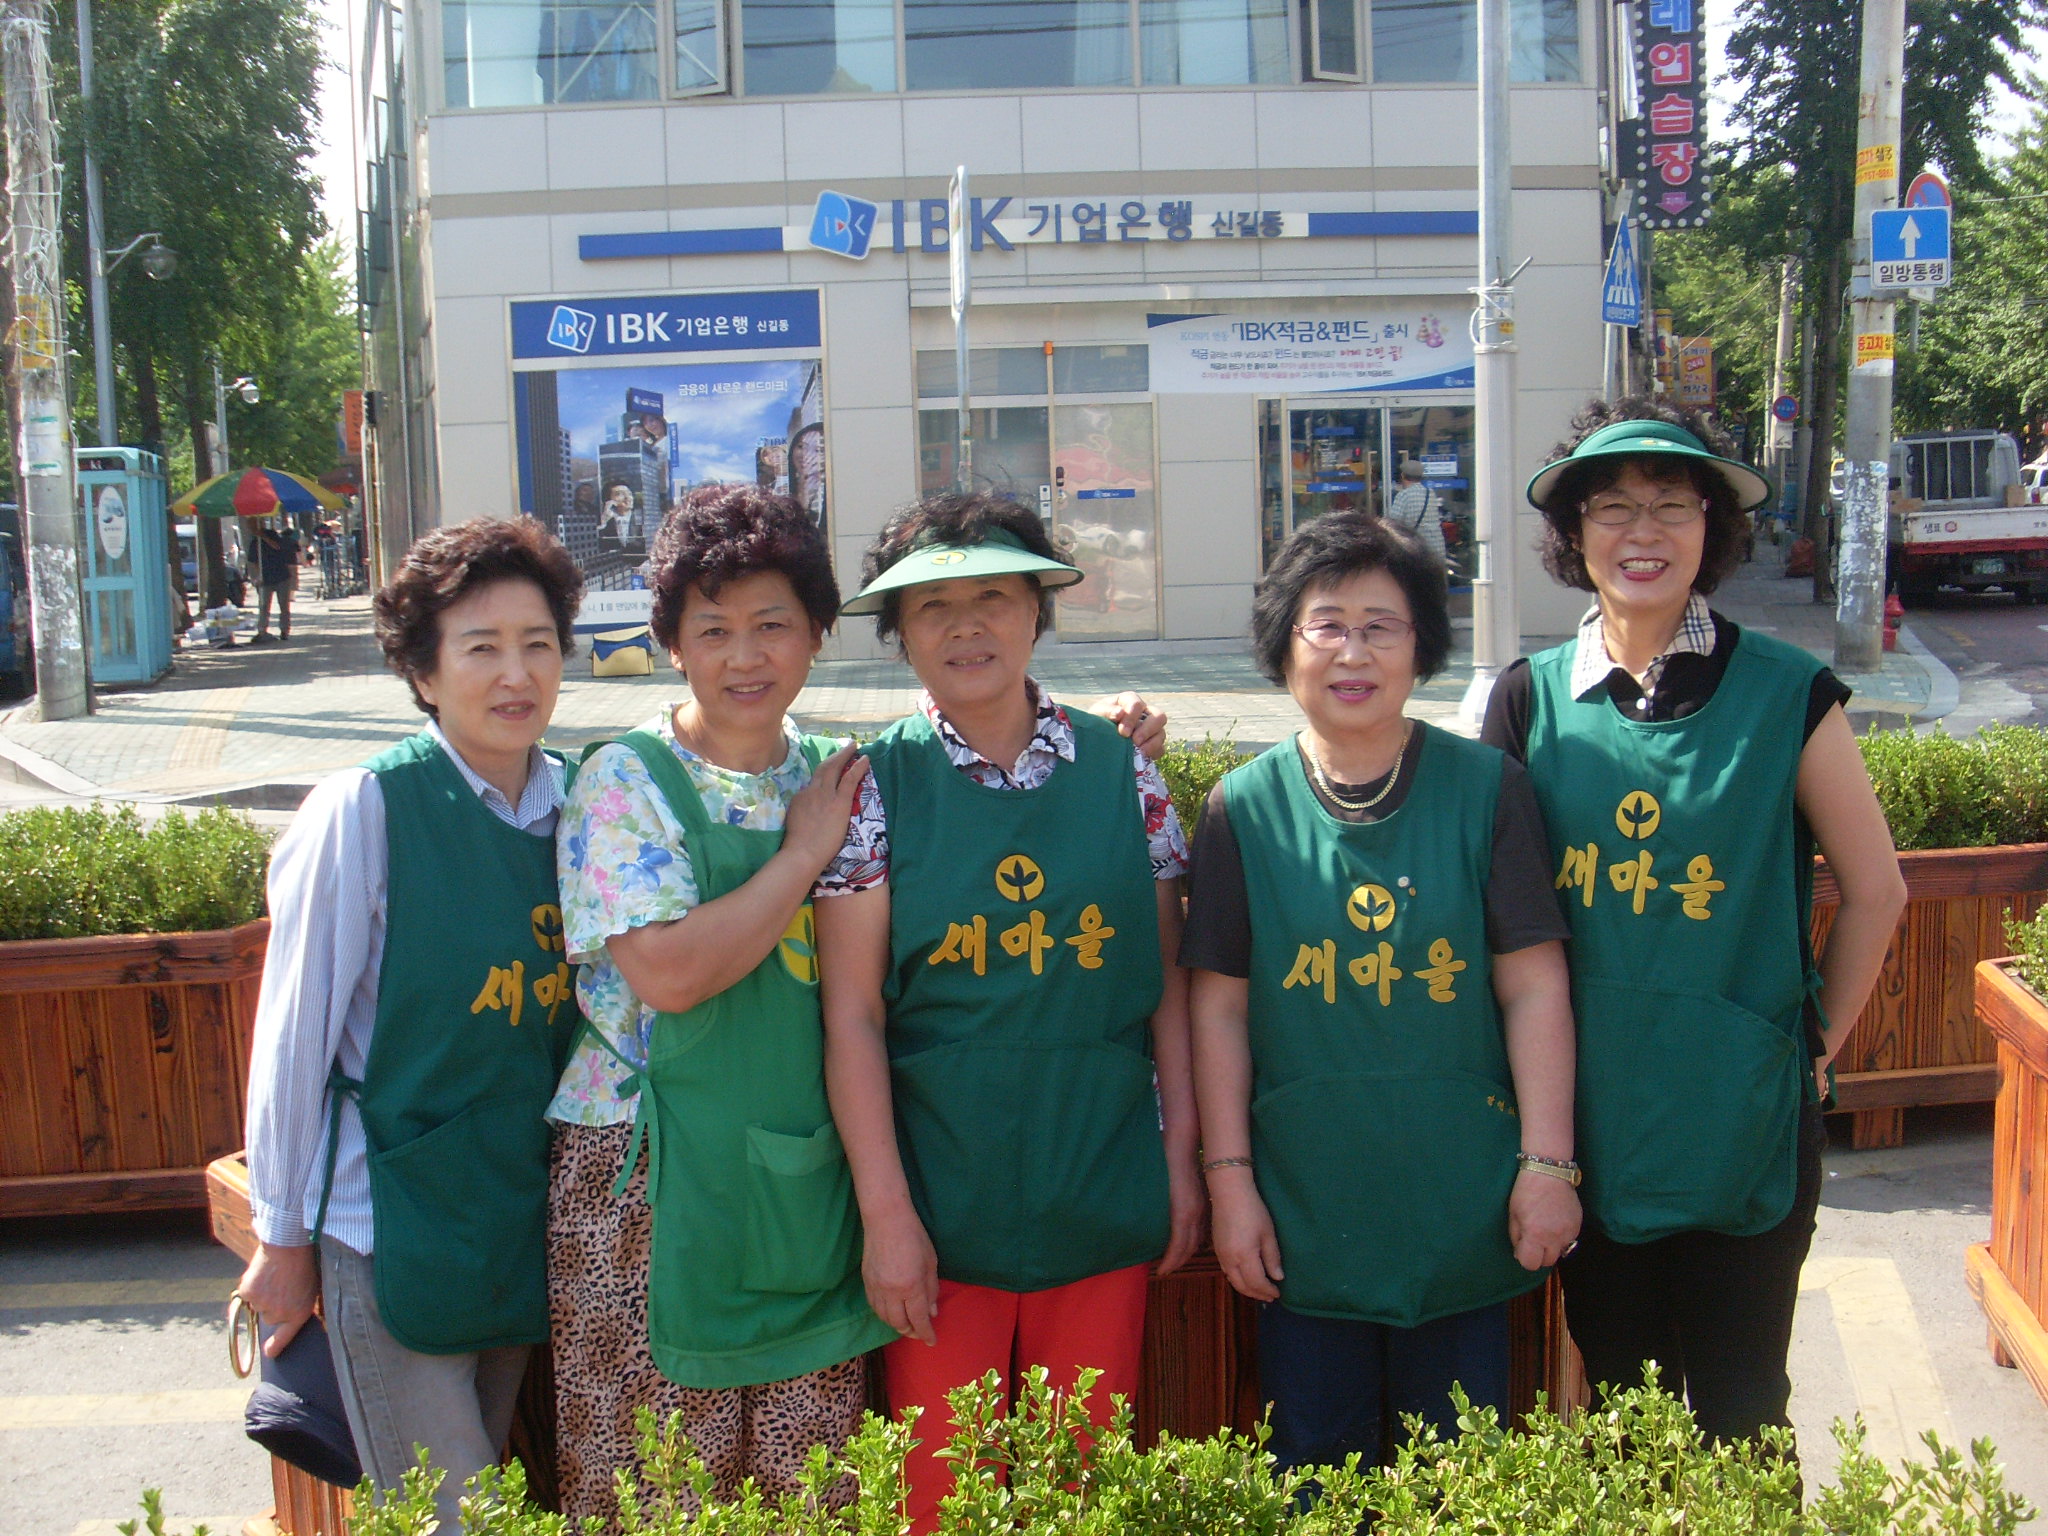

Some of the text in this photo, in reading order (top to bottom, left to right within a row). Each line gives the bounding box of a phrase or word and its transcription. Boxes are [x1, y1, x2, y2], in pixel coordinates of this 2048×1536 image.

[892, 196, 1284, 253] IBK 기업은행 신길동
[1880, 263, 1944, 283] 일방통행
[606, 311, 789, 344] IBK 기업은행 신길동
[1383, 323, 1409, 339] 출시
[678, 380, 788, 397] 금융의 새로운 랜드마크!
[1555, 842, 1725, 921] 새마을
[928, 903, 1116, 976] 새마을
[1282, 937, 1467, 1007] 새마을
